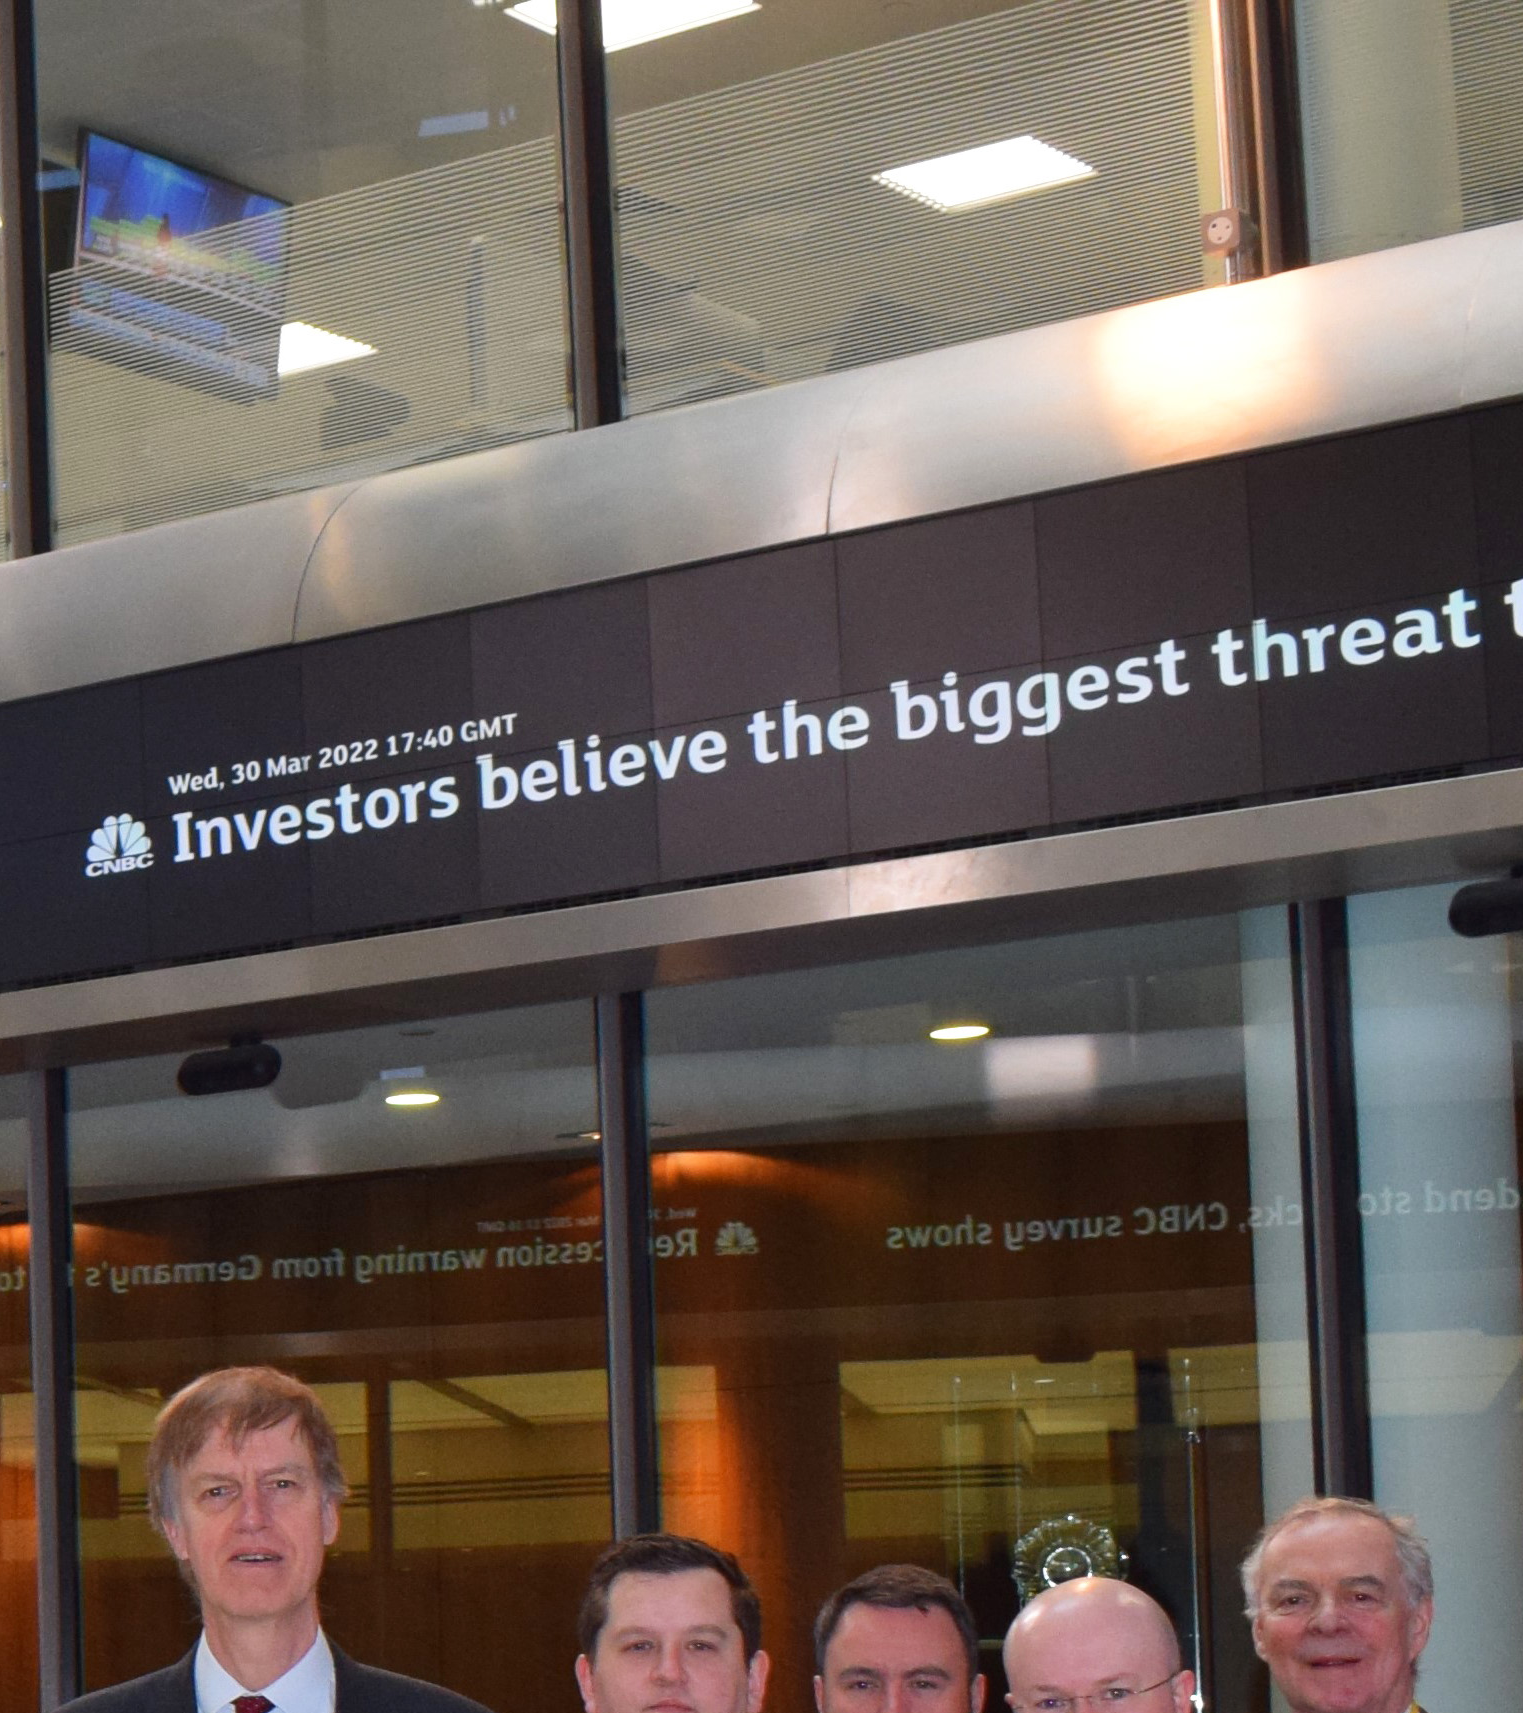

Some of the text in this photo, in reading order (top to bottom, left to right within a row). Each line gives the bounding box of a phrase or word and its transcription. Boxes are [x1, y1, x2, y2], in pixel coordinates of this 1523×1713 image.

[168, 713, 517, 795] Wed, 30 Mar 2022 17:40 GMT
[173, 775, 459, 863] Investors
[475, 729, 727, 810] believe
[747, 700, 869, 763] the
[890, 640, 1189, 744] biggest
[1211, 589, 1481, 686] threat
[85, 852, 154, 877] CNBC
